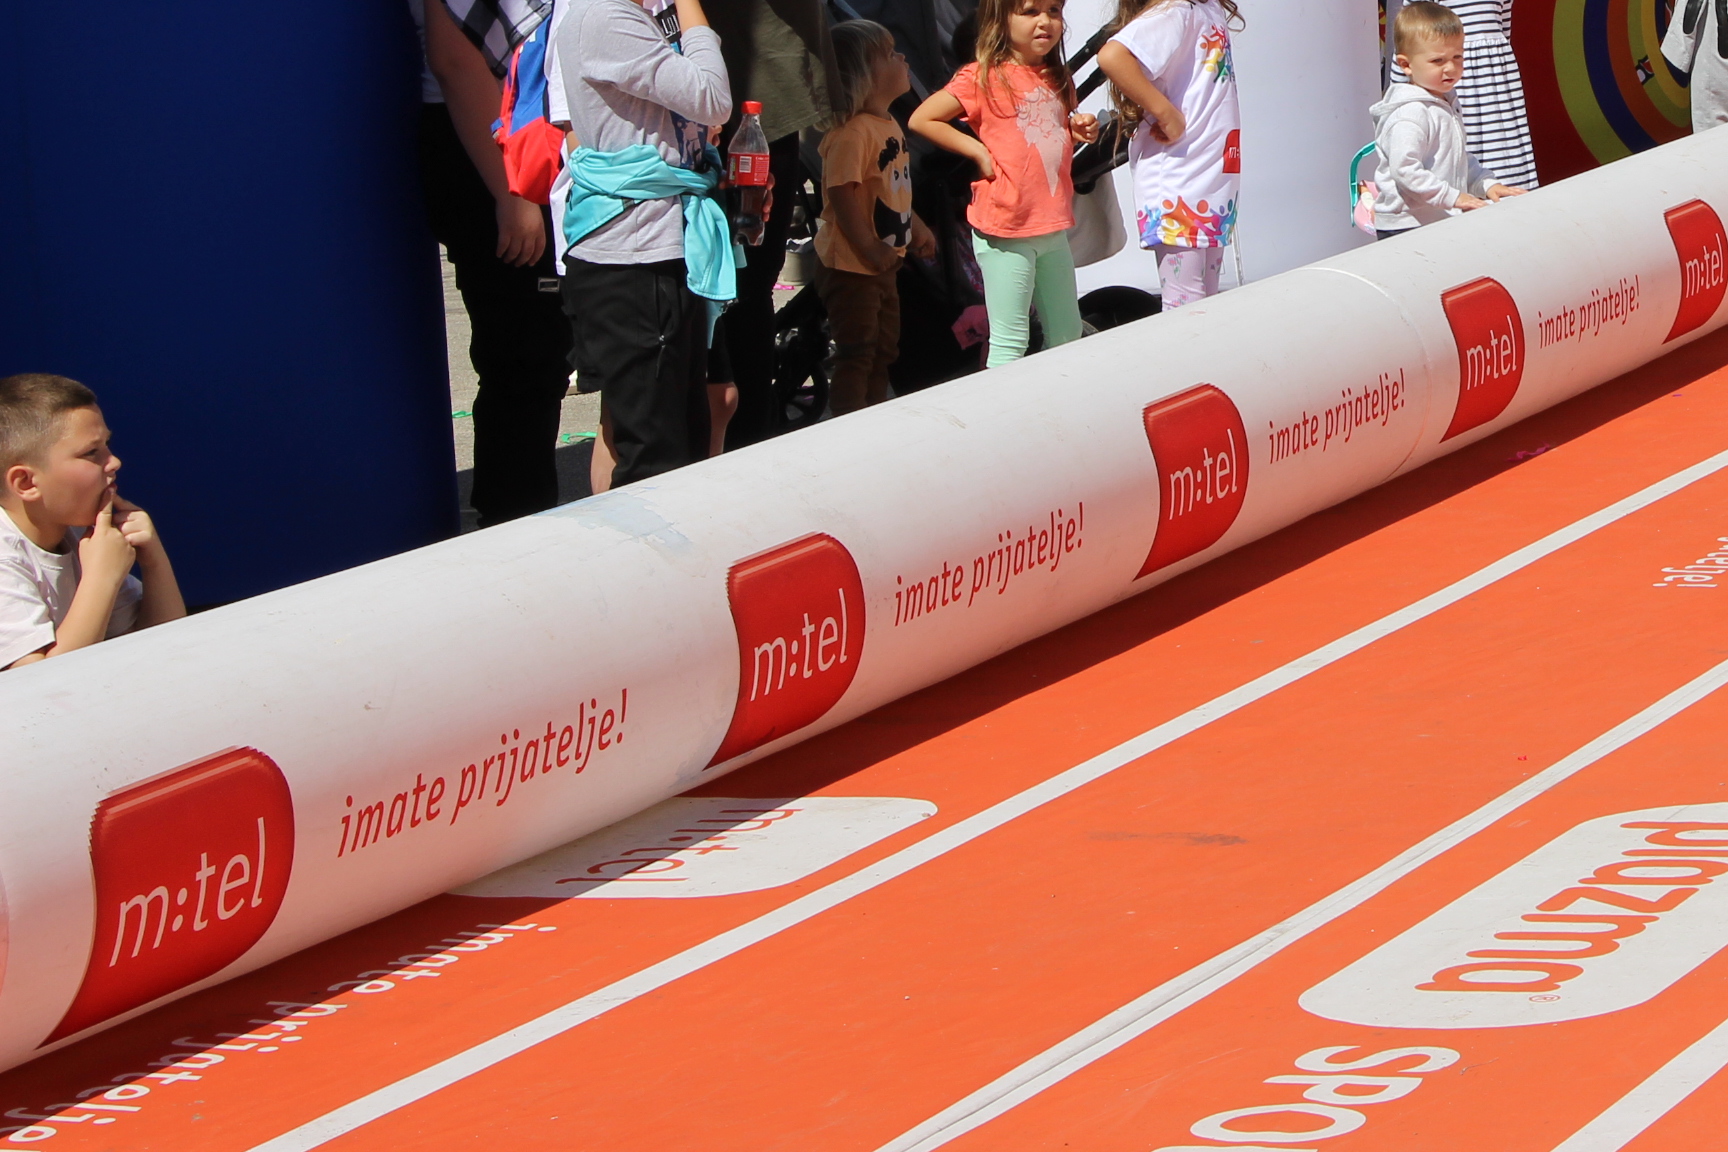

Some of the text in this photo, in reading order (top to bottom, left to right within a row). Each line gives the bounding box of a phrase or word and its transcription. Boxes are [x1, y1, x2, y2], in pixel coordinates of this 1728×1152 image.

[1538, 274, 1640, 349] imate prijatelje!
[1684, 232, 1726, 299] m:tel
[1466, 315, 1517, 391] m:tel
[1269, 368, 1405, 464] imate prijatelje!
[1168, 428, 1238, 520] m:tel
[894, 501, 1084, 627] imate prijatelje!
[749, 588, 848, 701] m:tel
[338, 688, 629, 858] imate prijatelje!
[108, 817, 266, 968] m:tel
[554, 808, 804, 885] m:tel
